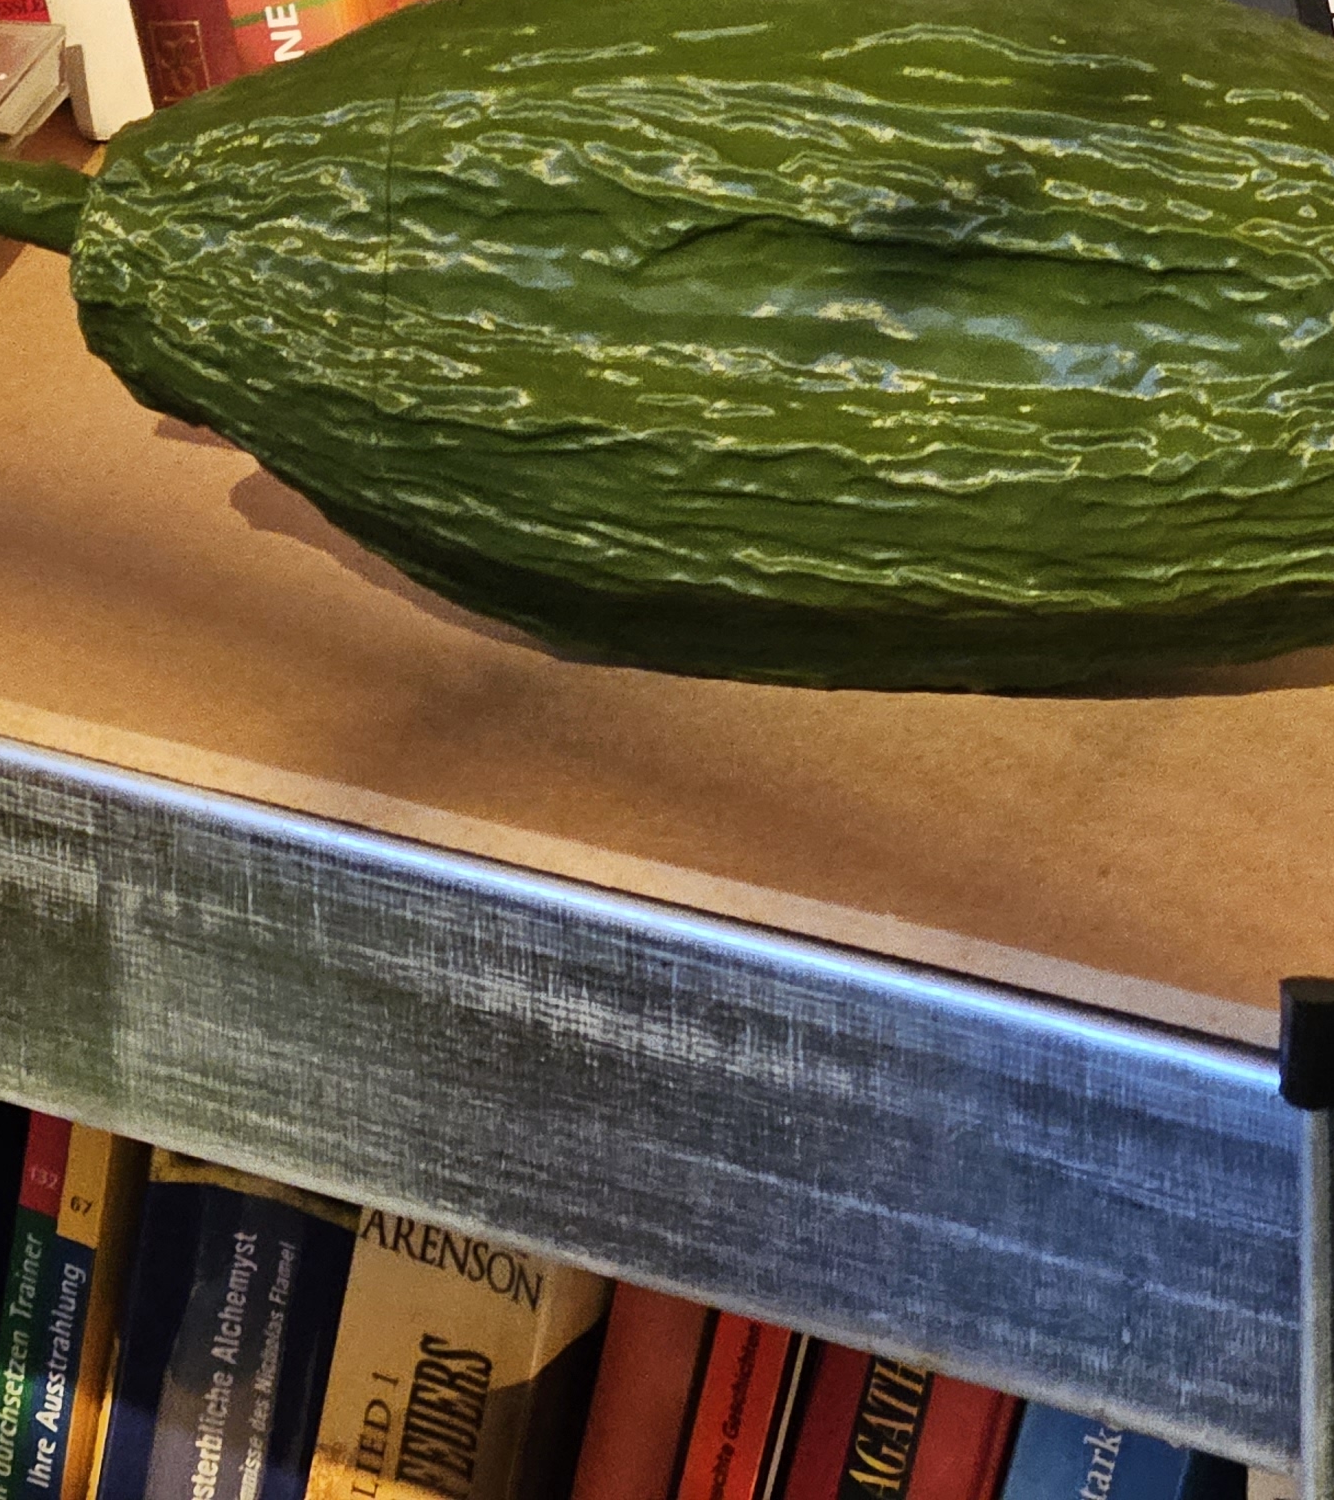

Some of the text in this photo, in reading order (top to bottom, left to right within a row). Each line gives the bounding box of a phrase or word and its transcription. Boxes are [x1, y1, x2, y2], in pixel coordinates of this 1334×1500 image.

[8, 1232, 44, 1321] Trainer
[268, 1239, 302, 1306] Flamel
[359, 1207, 544, 1312] ARENSON
[26, 1262, 88, 1491] Ihre Ausstrahlung
[189, 1230, 259, 1500] sterbliche Alchemyst
